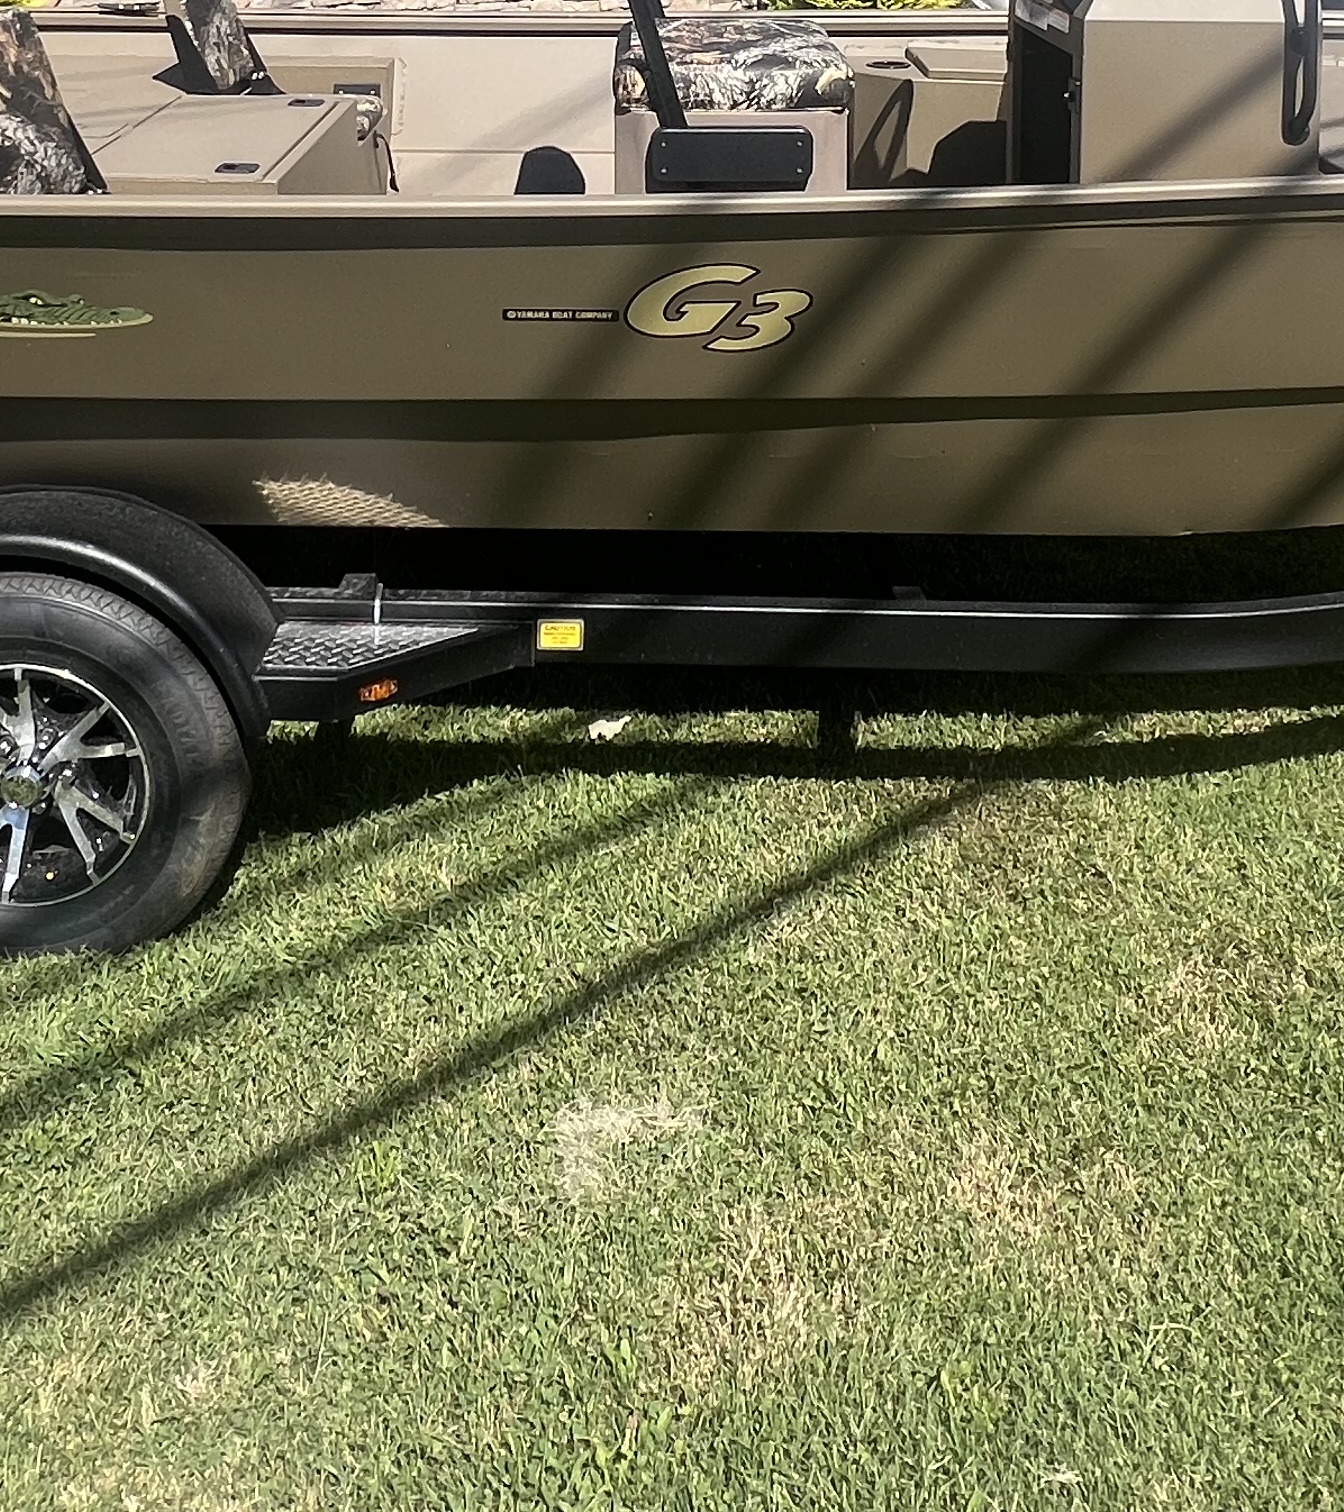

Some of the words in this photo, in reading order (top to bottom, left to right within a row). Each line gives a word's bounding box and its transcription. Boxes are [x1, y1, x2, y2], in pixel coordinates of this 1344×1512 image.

[516, 311, 550, 319] YAMAHA
[552, 311, 573, 319] BOAT
[575, 311, 613, 320] COMPANY
[624, 263, 814, 352] G3
